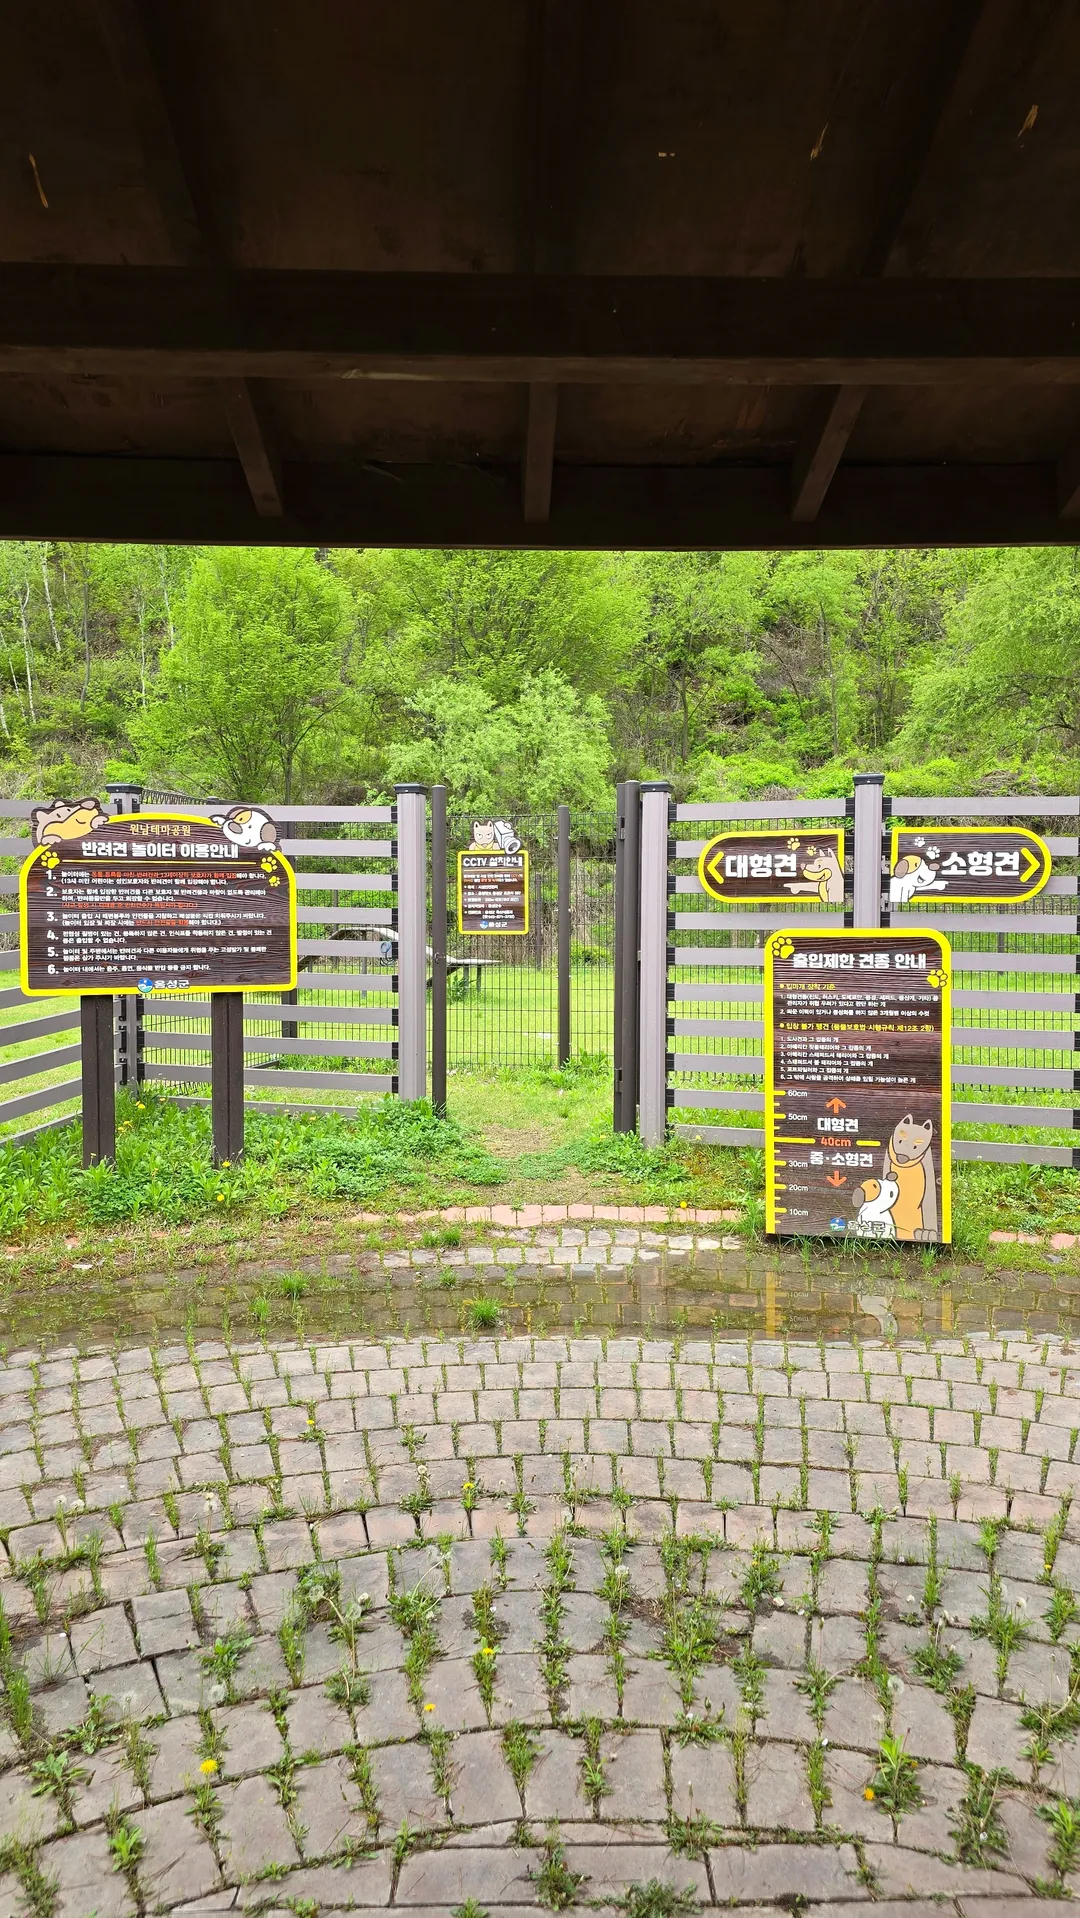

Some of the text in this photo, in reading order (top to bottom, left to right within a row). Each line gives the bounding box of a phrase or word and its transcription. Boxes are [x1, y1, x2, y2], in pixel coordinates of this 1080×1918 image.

[130, 824, 191, 836] 원남테마공원
[81, 842, 239, 858] 반려견 놀이터 이용안내
[462, 857, 523, 867] CCTV 설치안내
[725, 853, 798, 878] 대형견
[941, 851, 1020, 877] 소형견
[45, 870, 57, 880] 1.
[46, 886, 58, 897] 2.
[46, 911, 58, 922] 3.
[46, 930, 59, 940] 4.
[47, 946, 59, 957] 5.
[793, 953, 926, 969] 출입제한 견종 안내
[47, 964, 59, 974] 6.
[154, 980, 190, 989] 음성군
[786, 1023, 799, 1031] 입장
[787, 1090, 808, 1098] 60cm
[788, 1113, 808, 1121] 50cm
[817, 1118, 859, 1132] 대형견
[820, 1137, 852, 1147] 40cm
[788, 1160, 808, 1168] 30cm
[788, 1184, 809, 1192] 20cm
[789, 1208, 809, 1216] 10cm
